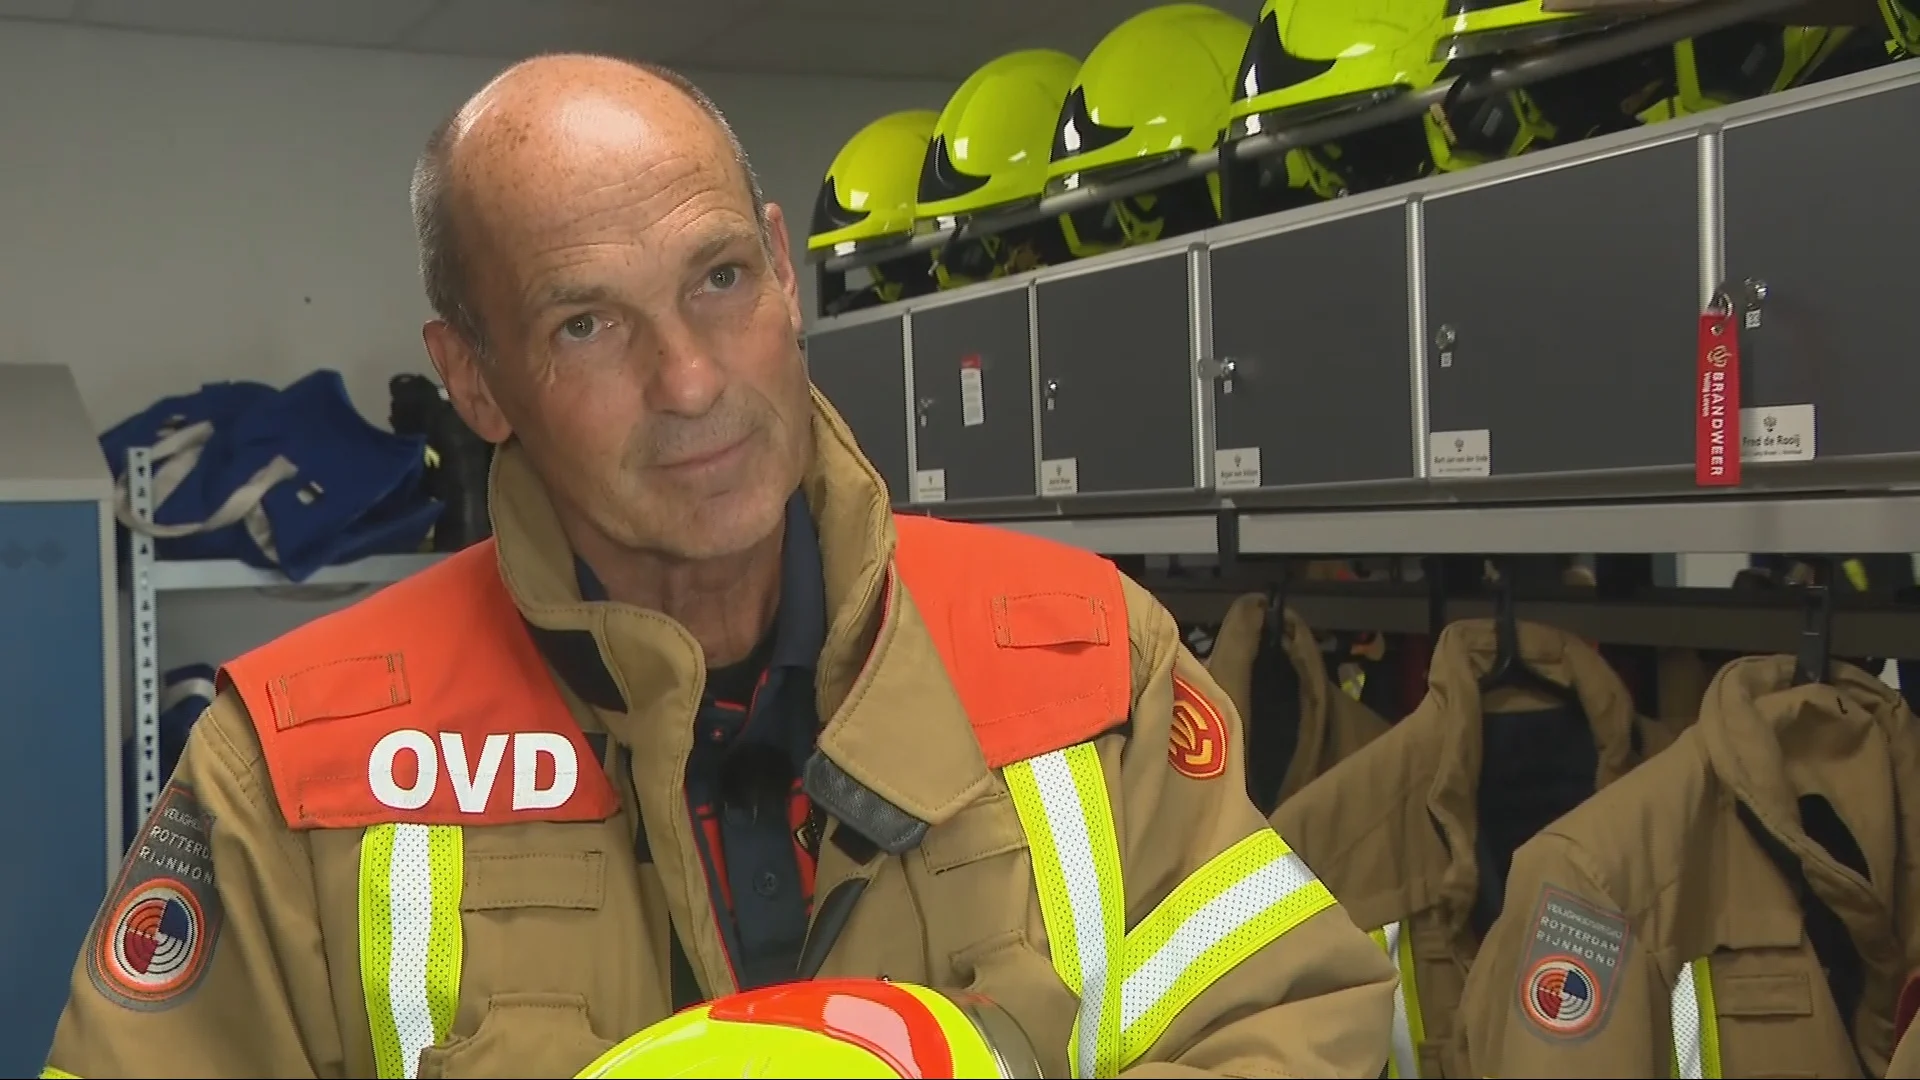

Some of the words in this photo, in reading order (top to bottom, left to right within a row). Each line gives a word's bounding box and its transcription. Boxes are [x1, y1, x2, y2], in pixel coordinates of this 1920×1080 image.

[1710, 371, 1725, 476] BRANDWEER
[1763, 436, 1775, 446] de
[367, 728, 580, 814] OVD
[149, 824, 212, 860] ROTTERD
[139, 844, 215, 885] RIJNMON
[1536, 929, 1616, 968] RIJNMOND
[1540, 915, 1620, 953] ROTTERDAM
